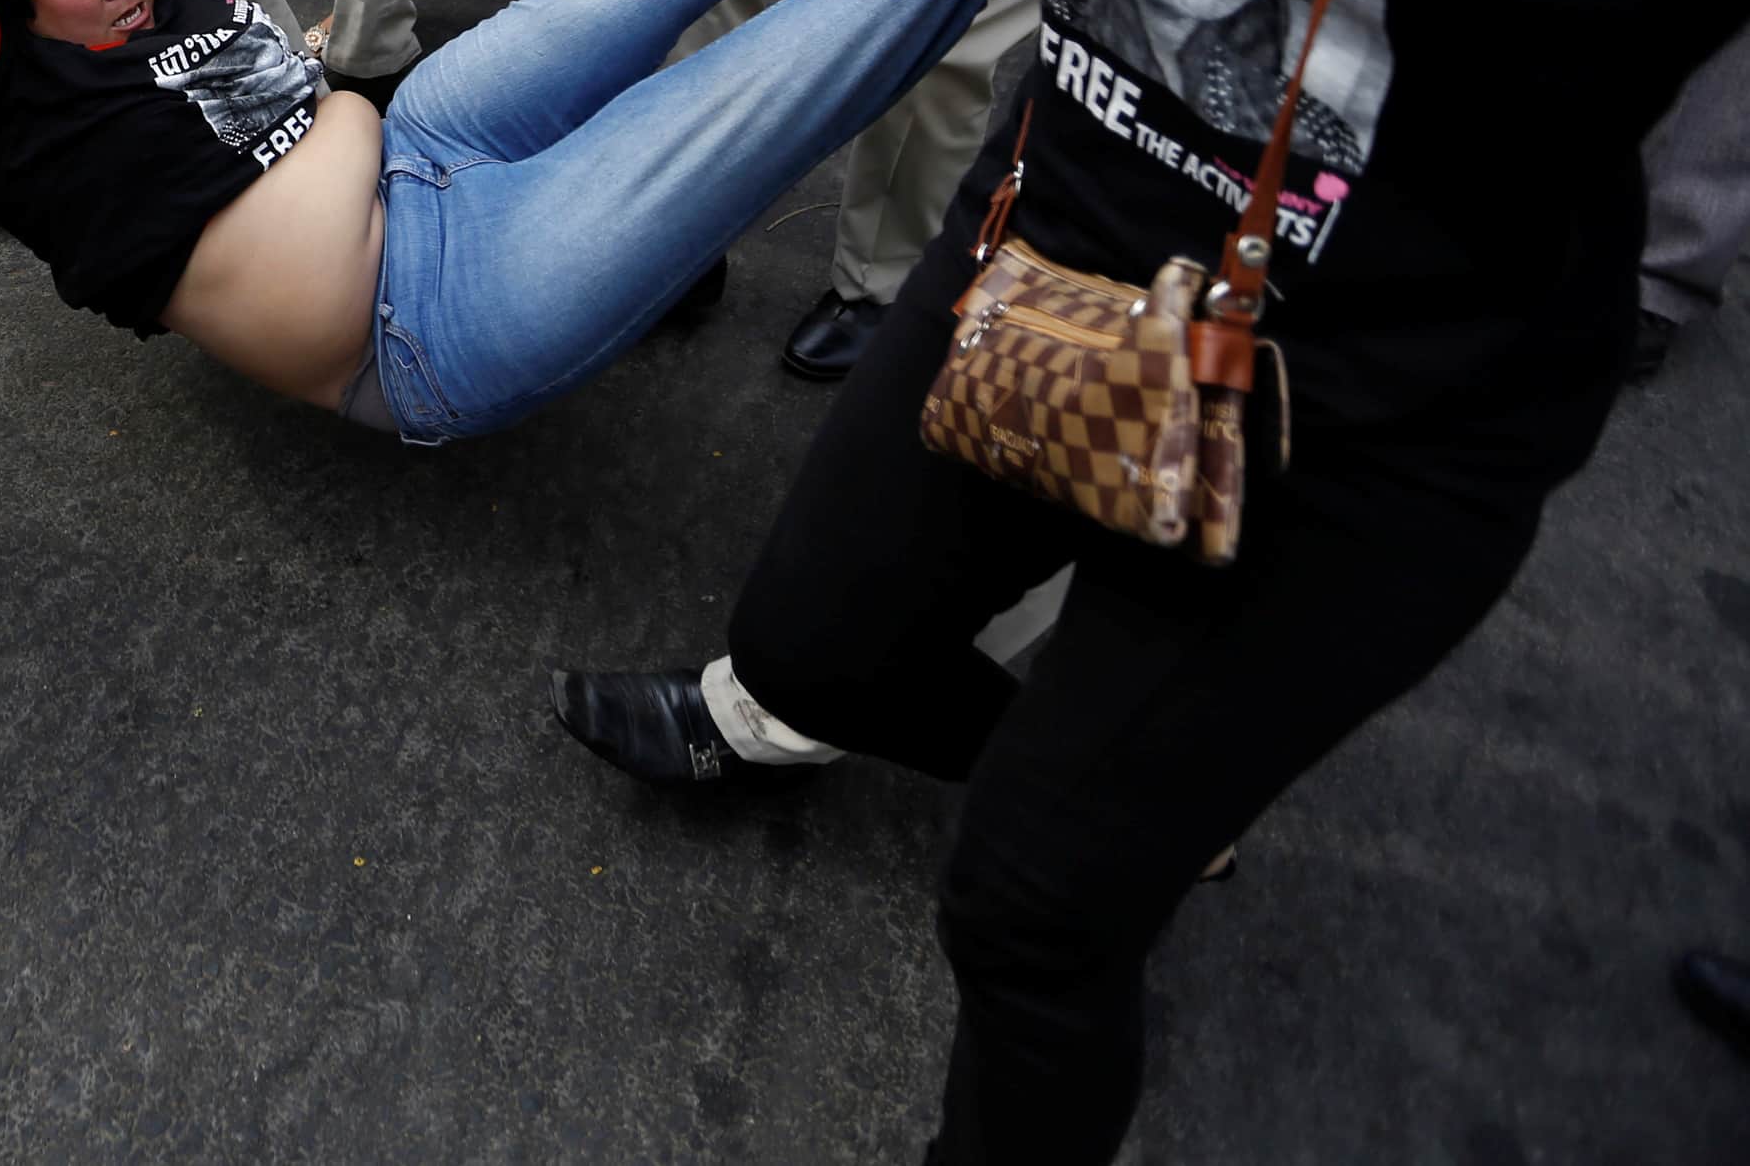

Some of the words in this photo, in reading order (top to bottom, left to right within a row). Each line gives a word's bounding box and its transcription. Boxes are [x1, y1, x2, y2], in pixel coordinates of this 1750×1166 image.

[1040, 21, 1142, 140] FREE
[1135, 123, 1183, 169] THE
[1182, 153, 1317, 246] ACTIVTS
